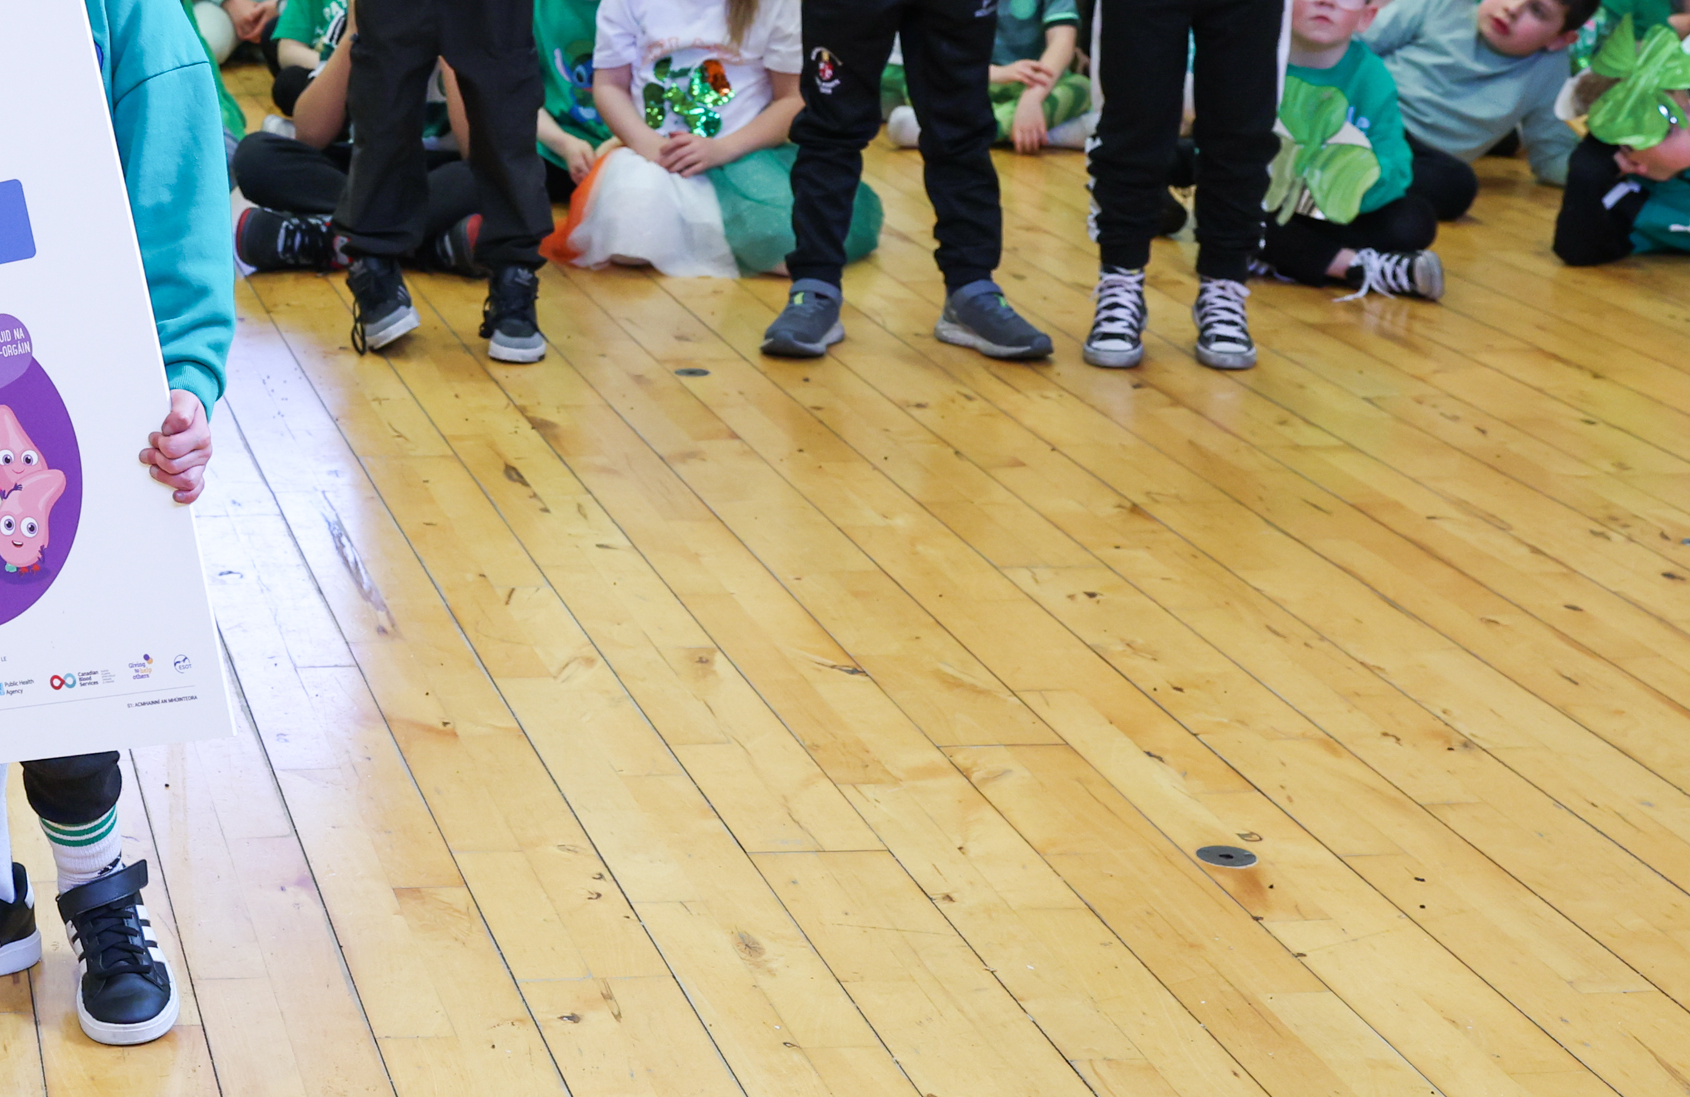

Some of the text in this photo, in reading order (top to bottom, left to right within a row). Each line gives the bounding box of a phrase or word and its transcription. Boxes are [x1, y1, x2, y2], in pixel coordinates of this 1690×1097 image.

[13, 327, 25, 340] NA
[128, 661, 146, 669] Giving
[19, 678, 34, 686] Health
[6, 688, 23, 696] Agency
